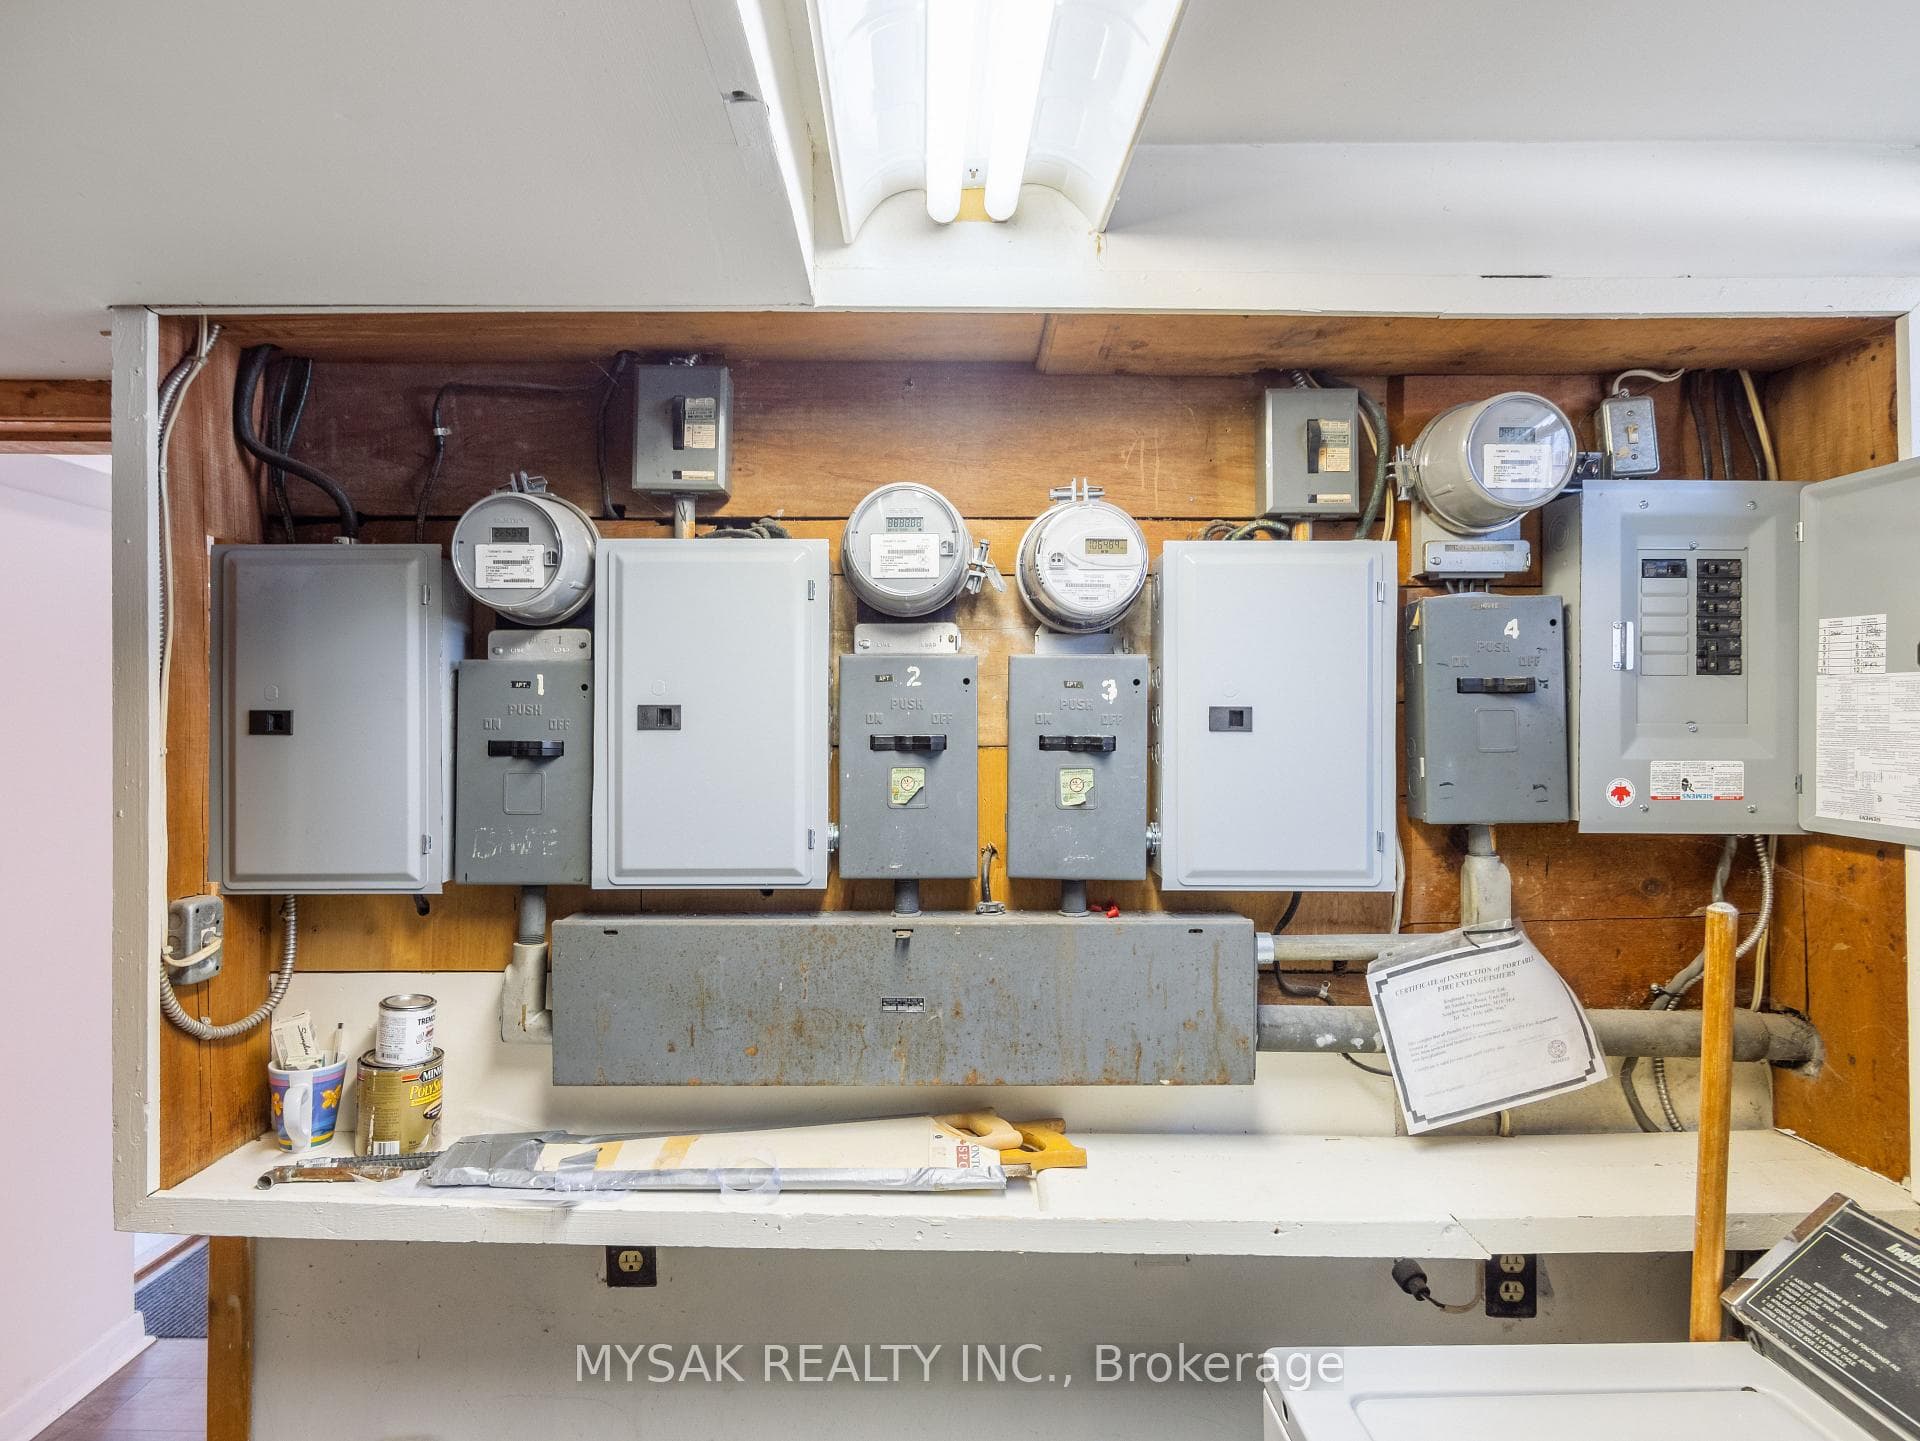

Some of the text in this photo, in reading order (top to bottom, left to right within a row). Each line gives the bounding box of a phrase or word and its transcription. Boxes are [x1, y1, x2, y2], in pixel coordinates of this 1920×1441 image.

[1504, 618, 1520, 639] 4
[1476, 641, 1511, 653] PUSH
[1452, 656, 1470, 667] ON
[1519, 656, 1540, 667] OFF
[906, 666, 922, 686] 2
[537, 674, 544, 695] 1
[1102, 679, 1118, 704] 3
[890, 697, 924, 710] PUSH
[1060, 699, 1094, 710] PUSH
[508, 704, 542, 716] PUSH
[549, 718, 570, 730] OFF
[865, 712, 883, 724] ON
[931, 712, 952, 724] OFF
[1035, 712, 1052, 725] ON
[1100, 714, 1122, 726] OFF
[484, 718, 501, 731] ON
[1395, 980, 1439, 996] CERTIFICATE
[1447, 966, 1492, 983] INSPECTION
[1437, 970, 1516, 993] FIRE EXTINGUISHERS
